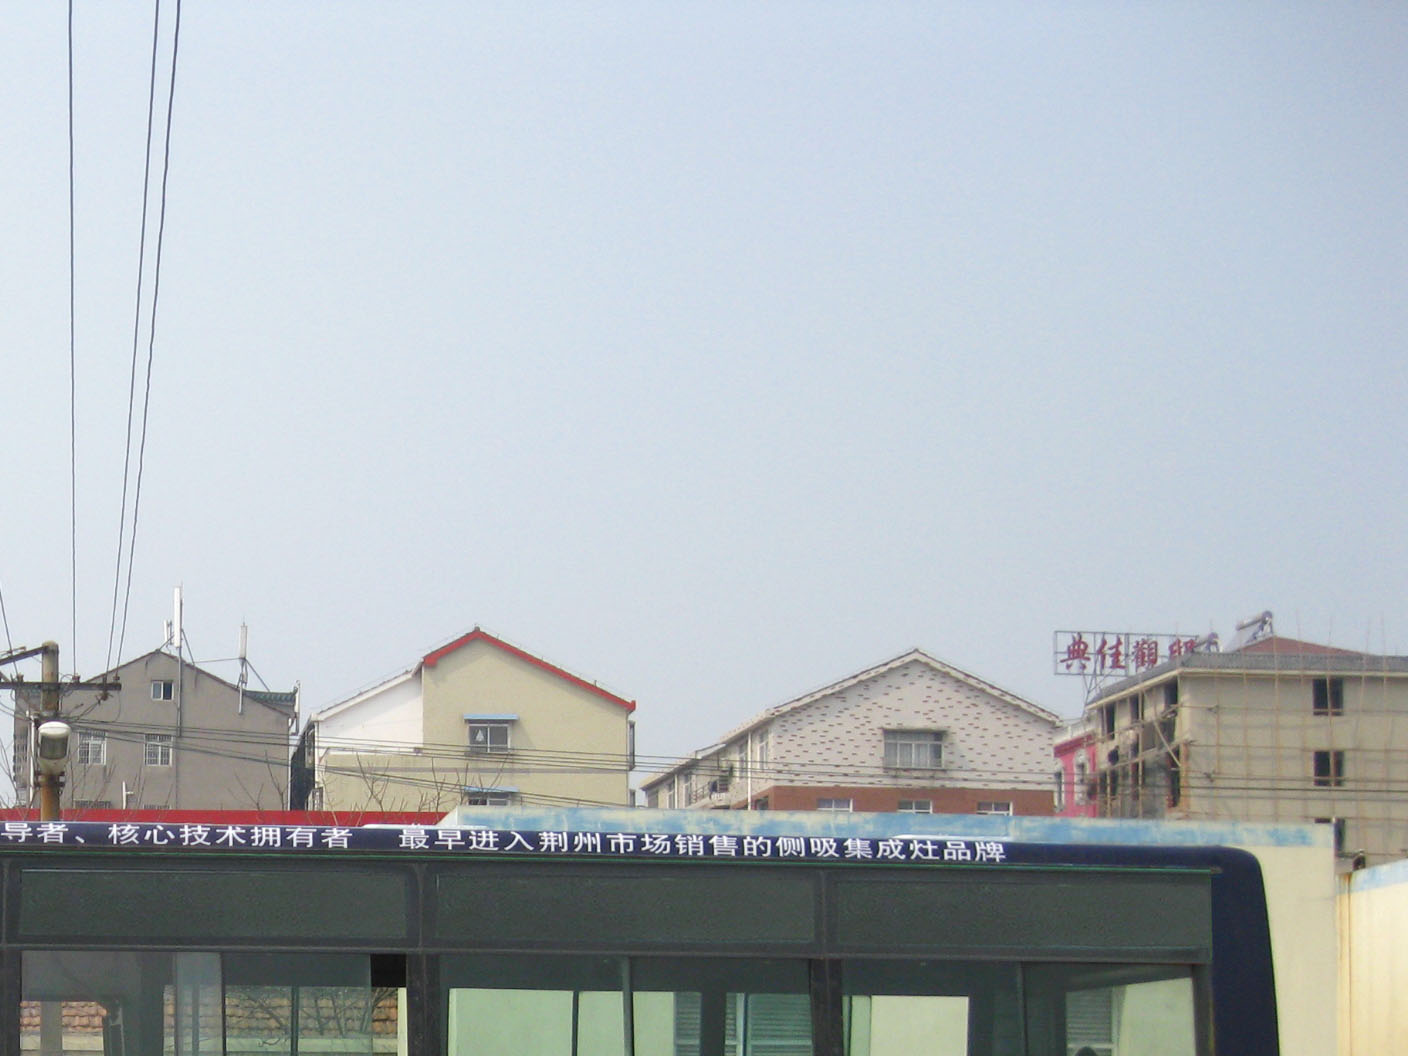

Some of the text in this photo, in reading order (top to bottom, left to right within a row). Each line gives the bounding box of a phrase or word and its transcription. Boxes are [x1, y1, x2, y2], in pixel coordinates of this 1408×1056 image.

[398, 827, 1006, 863] 最早进入荆州市场销售的侧吸集成灶品牌
